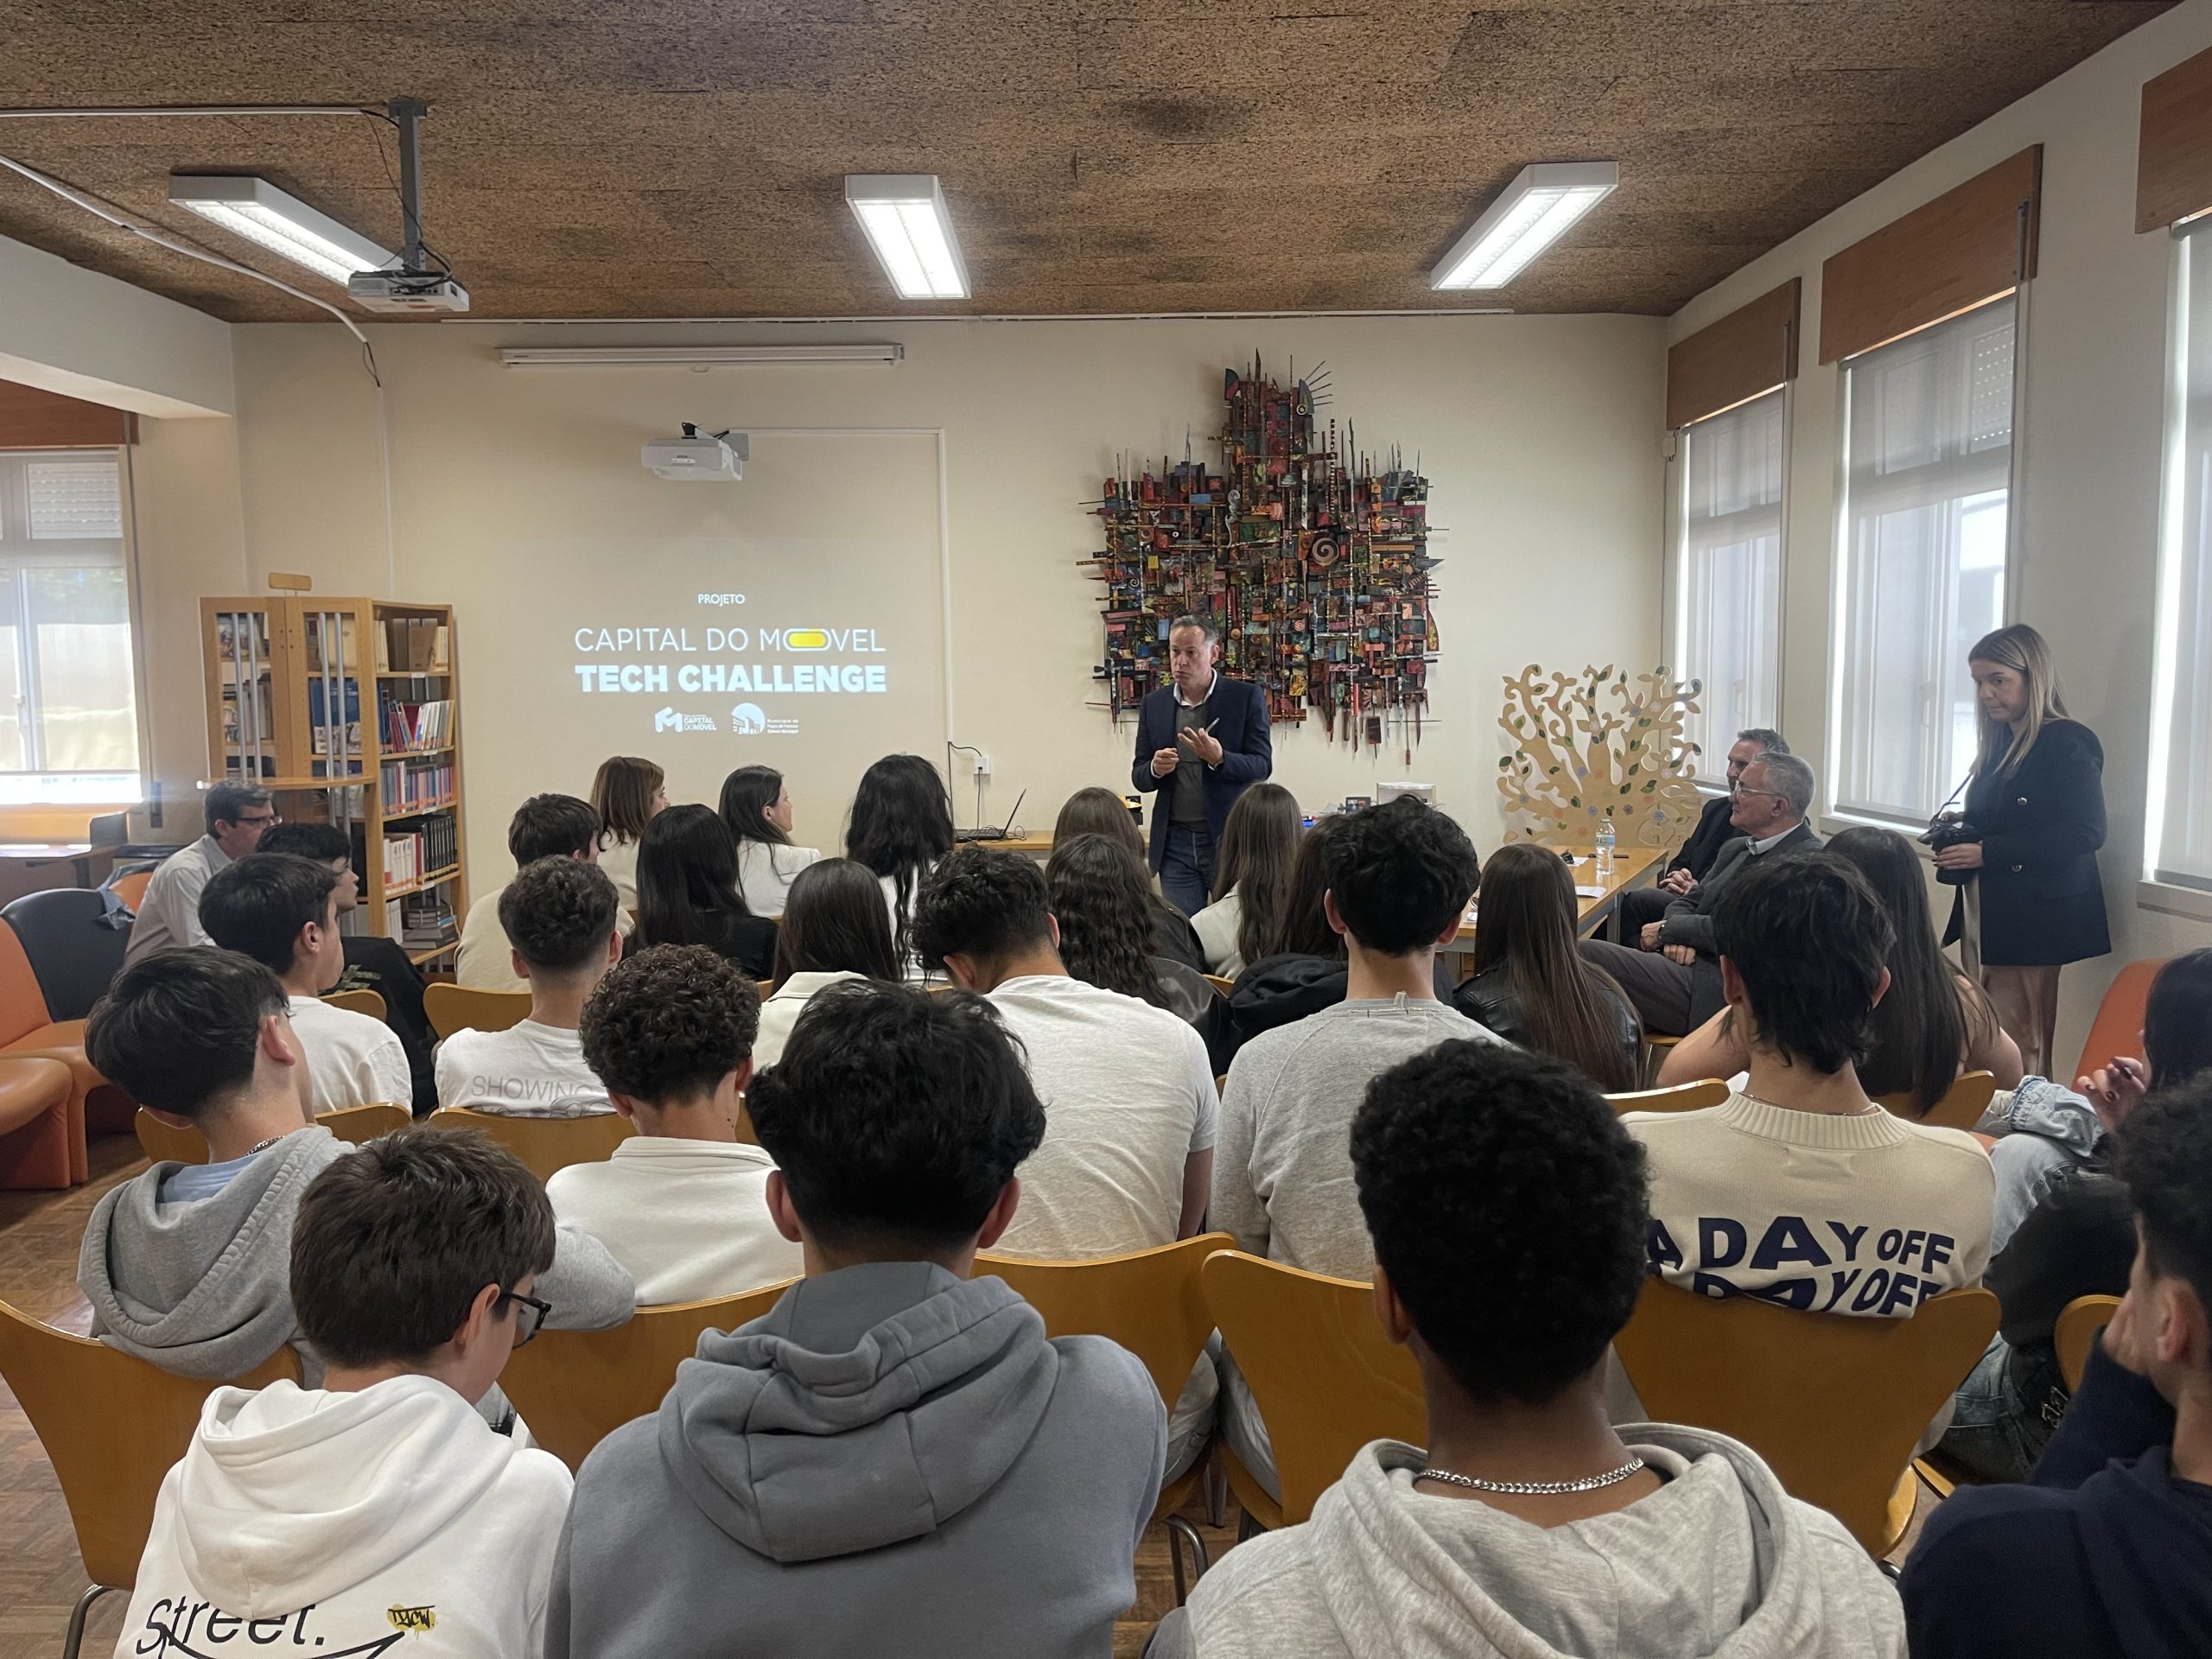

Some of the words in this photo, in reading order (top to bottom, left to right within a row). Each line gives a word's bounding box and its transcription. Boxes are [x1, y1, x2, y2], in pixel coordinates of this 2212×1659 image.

[697, 594, 746, 607] PROJETO
[575, 627, 696, 652] CAPITAL
[707, 627, 749, 652] DO
[575, 664, 669, 692] TECH
[677, 664, 887, 692] CHALLENGE
[1646, 1219, 1684, 1270] A
[1698, 1216, 1869, 1270] DAY
[1876, 1229, 1955, 1274] OFF
